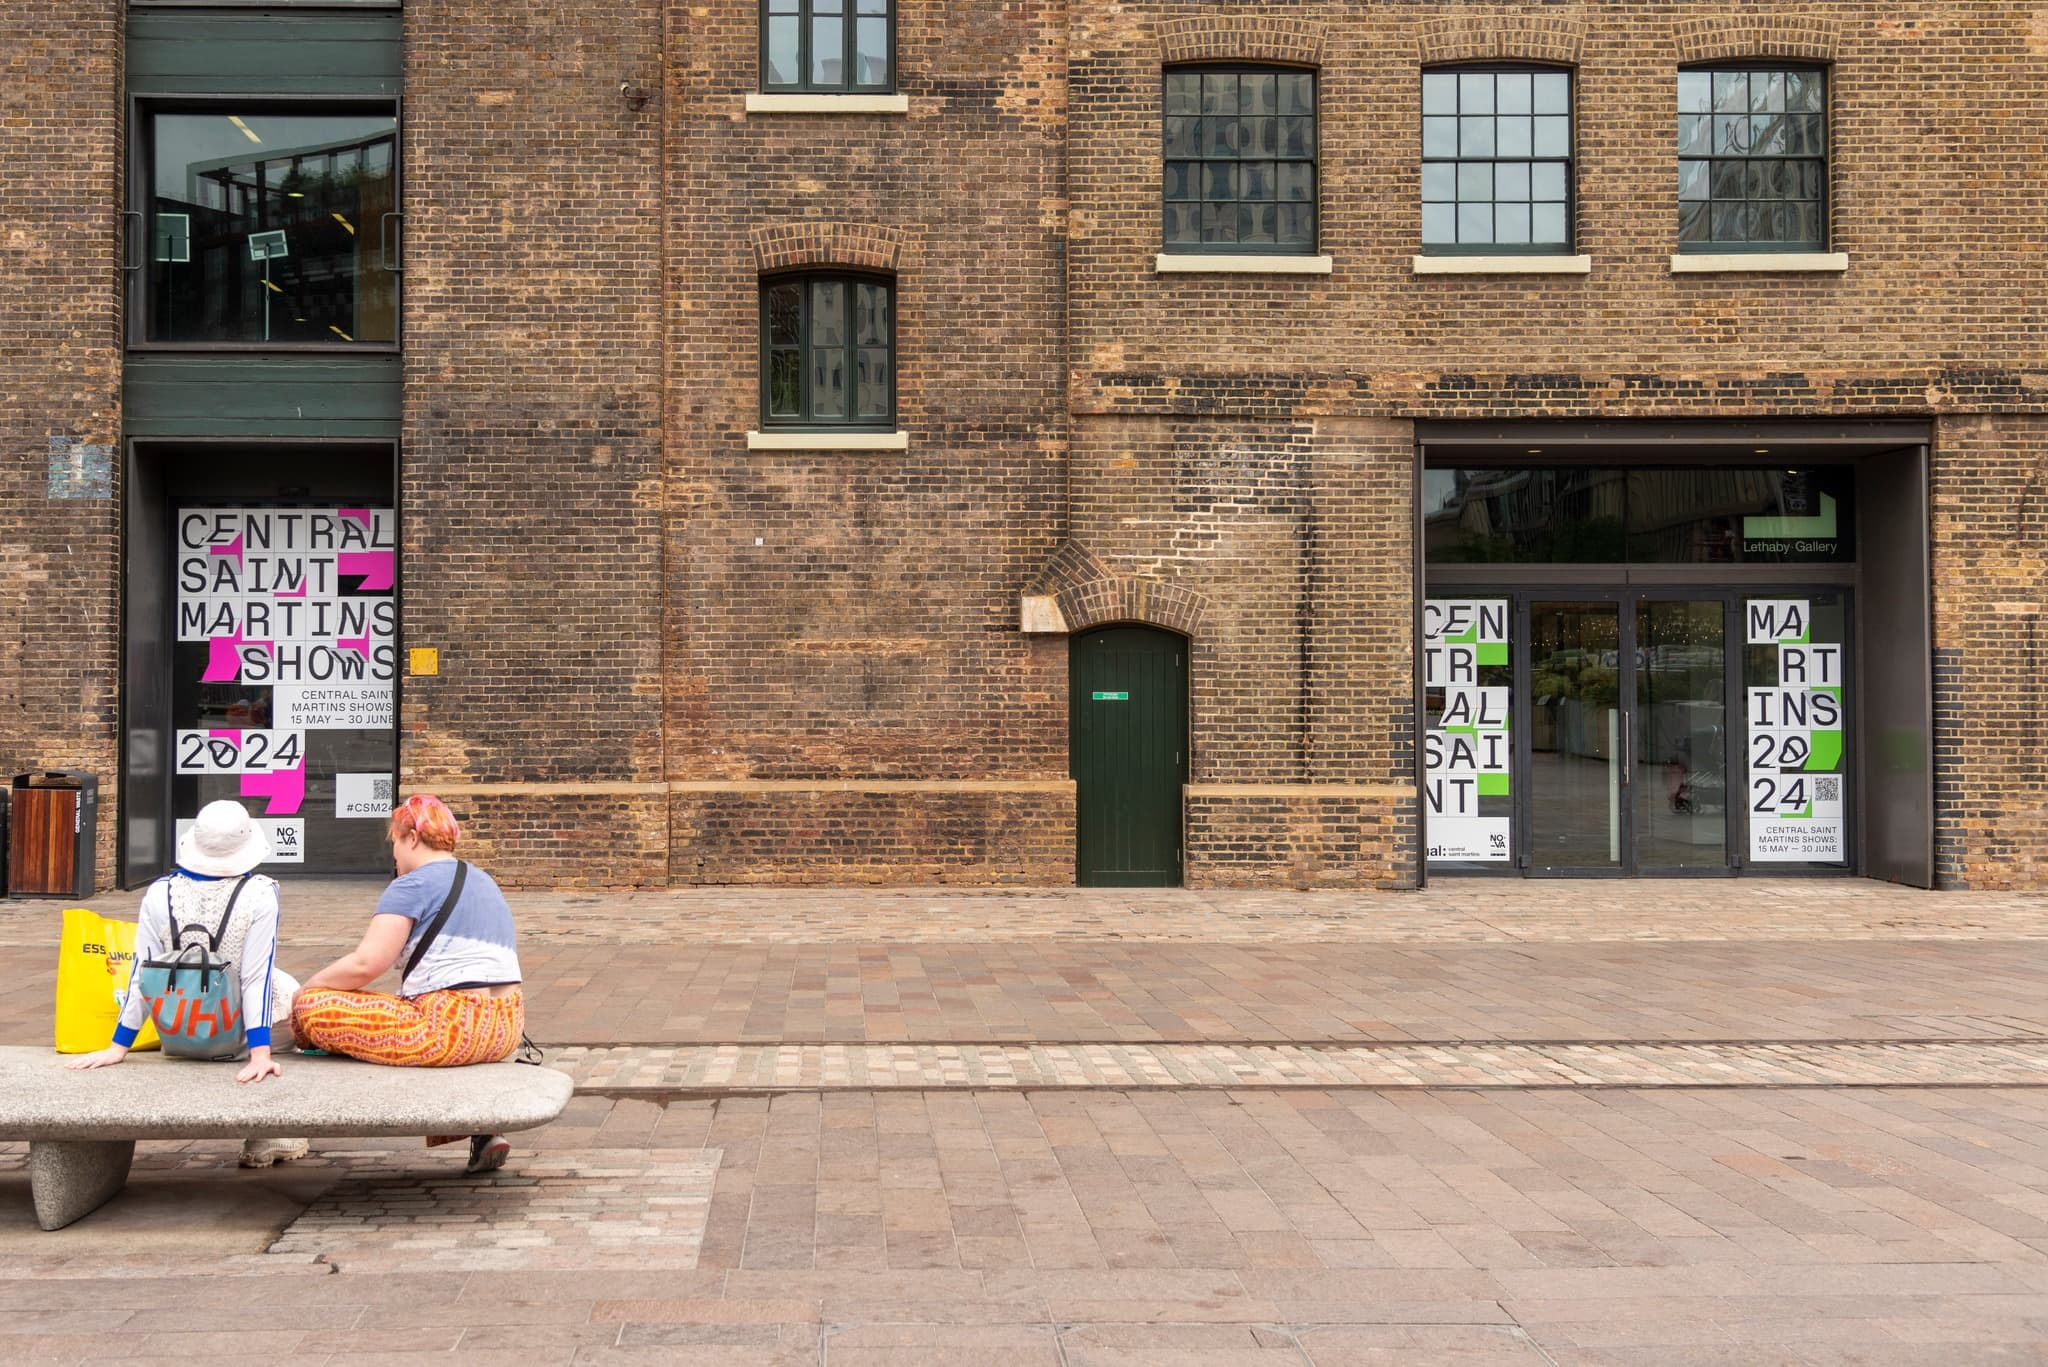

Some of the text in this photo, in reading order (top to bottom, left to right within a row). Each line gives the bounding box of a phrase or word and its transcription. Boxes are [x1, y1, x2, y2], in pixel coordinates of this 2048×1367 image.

[181, 513, 394, 550] CENTRAL
[1744, 541, 1837, 554] Lethaby Gallery
[181, 558, 334, 593] SAINT
[180, 601, 394, 637] MARTINS
[1425, 605, 1503, 639] CEN
[1750, 605, 1802, 639] MA
[243, 645, 394, 680] SHOWS
[1425, 648, 1472, 682] TR
[1783, 648, 1837, 682] RT
[292, 703, 346, 712] MARTINS
[302, 690, 393, 700] CENTRAL SAINT
[1442, 692, 1502, 724] AL
[1754, 692, 1838, 726] INS
[290, 715, 302, 724] 15
[306, 715, 331, 724] MAY
[348, 715, 363, 724] 30
[366, 715, 393, 724] JUNE
[180, 733, 300, 768] 2024
[1426, 734, 1503, 769] SAI
[1753, 734, 1808, 768] 20
[1426, 779, 1474, 813] NT
[1753, 778, 1807, 812] 24
[1759, 835, 1837, 843] MARTINS SHOWS:
[1766, 826, 1837, 834] CENTRAL SAINT
